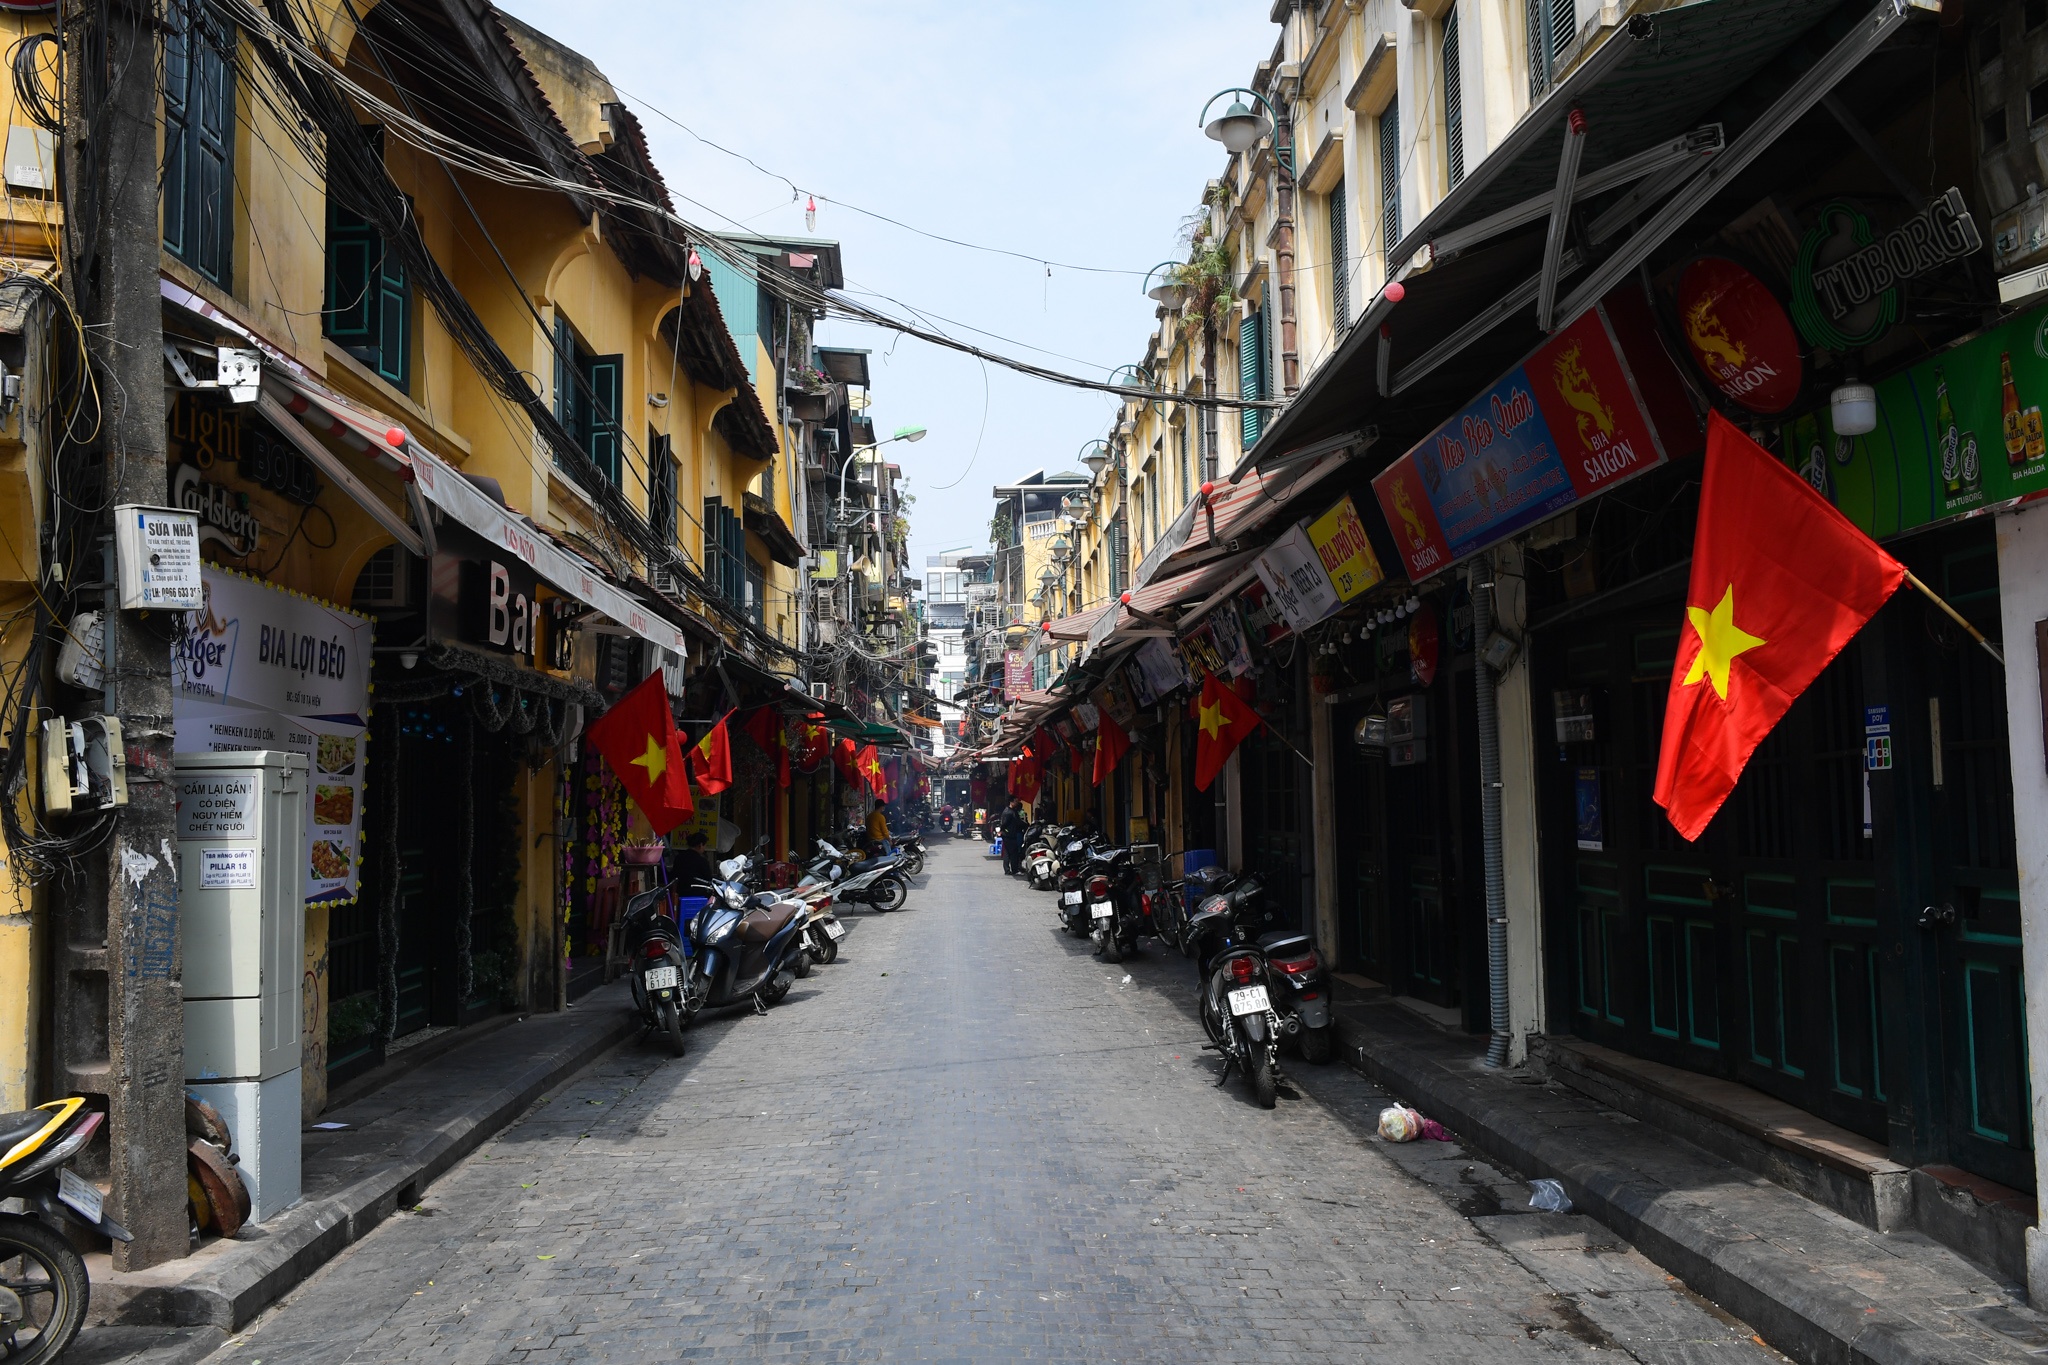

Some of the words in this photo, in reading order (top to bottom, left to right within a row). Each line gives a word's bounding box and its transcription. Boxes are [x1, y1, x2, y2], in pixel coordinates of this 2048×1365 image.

[1812, 186, 1980, 320] TUBORG
[1719, 361, 1777, 399] SAIGON
[1720, 364, 1740, 379] BIA
[173, 391, 241, 469] Light
[1437, 435, 1466, 474] Mèo
[1462, 415, 1494, 457] Béo
[1491, 387, 1533, 439] Quán
[1590, 431, 1610, 450] BIA
[252, 430, 319, 505] BOLD
[1513, 455, 1531, 476] ACID
[1531, 442, 1550, 466] JAZZ
[1583, 439, 1637, 483] SAIGON
[2013, 470, 2023, 480] BIA
[2024, 464, 2046, 477] HALIDA
[174, 463, 261, 552] Carlsberg
[1946, 499, 1957, 510] BIA
[1957, 491, 1982, 506] TUBORG
[149, 519, 170, 537] SỬA
[172, 521, 194, 537] NHÀ
[1414, 537, 1425, 550] BIA
[1319, 542, 1340, 573] BIA
[1411, 544, 1440, 572] SAIGON
[1291, 567, 1316, 595] BEER
[1304, 561, 1322, 586] 23
[152, 588, 161, 597] LH:
[178, 588, 189, 597] 633
[1275, 584, 1299, 616] Tiger
[489, 561, 541, 657] Bar
[259, 624, 287, 668] BIA
[291, 632, 315, 680] LỢI
[319, 635, 346, 680] BÉO
[1867, 707, 1887, 715] SAMSUNG
[1872, 714, 1883, 724] pay
[214, 724, 243, 737] HEINEKEN
[288, 733, 307, 744] 25.000
[213, 742, 241, 751] HEINEKEN
[1869, 747, 1889, 759] JCB
[184, 781, 206, 795] CẤM
[208, 785, 223, 797] LẠI
[226, 780, 246, 794] GẦN
[199, 799, 213, 808] CÓ
[215, 798, 236, 810] ĐIỆN
[221, 808, 242, 819] HIỂM
[189, 821, 213, 831] CHẾT
[216, 822, 245, 831] NGƯỜI
[650, 978, 673, 988] 6130
[1234, 989, 1262, 1001] 29-C1
[1235, 998, 1268, 1014] 875.80
